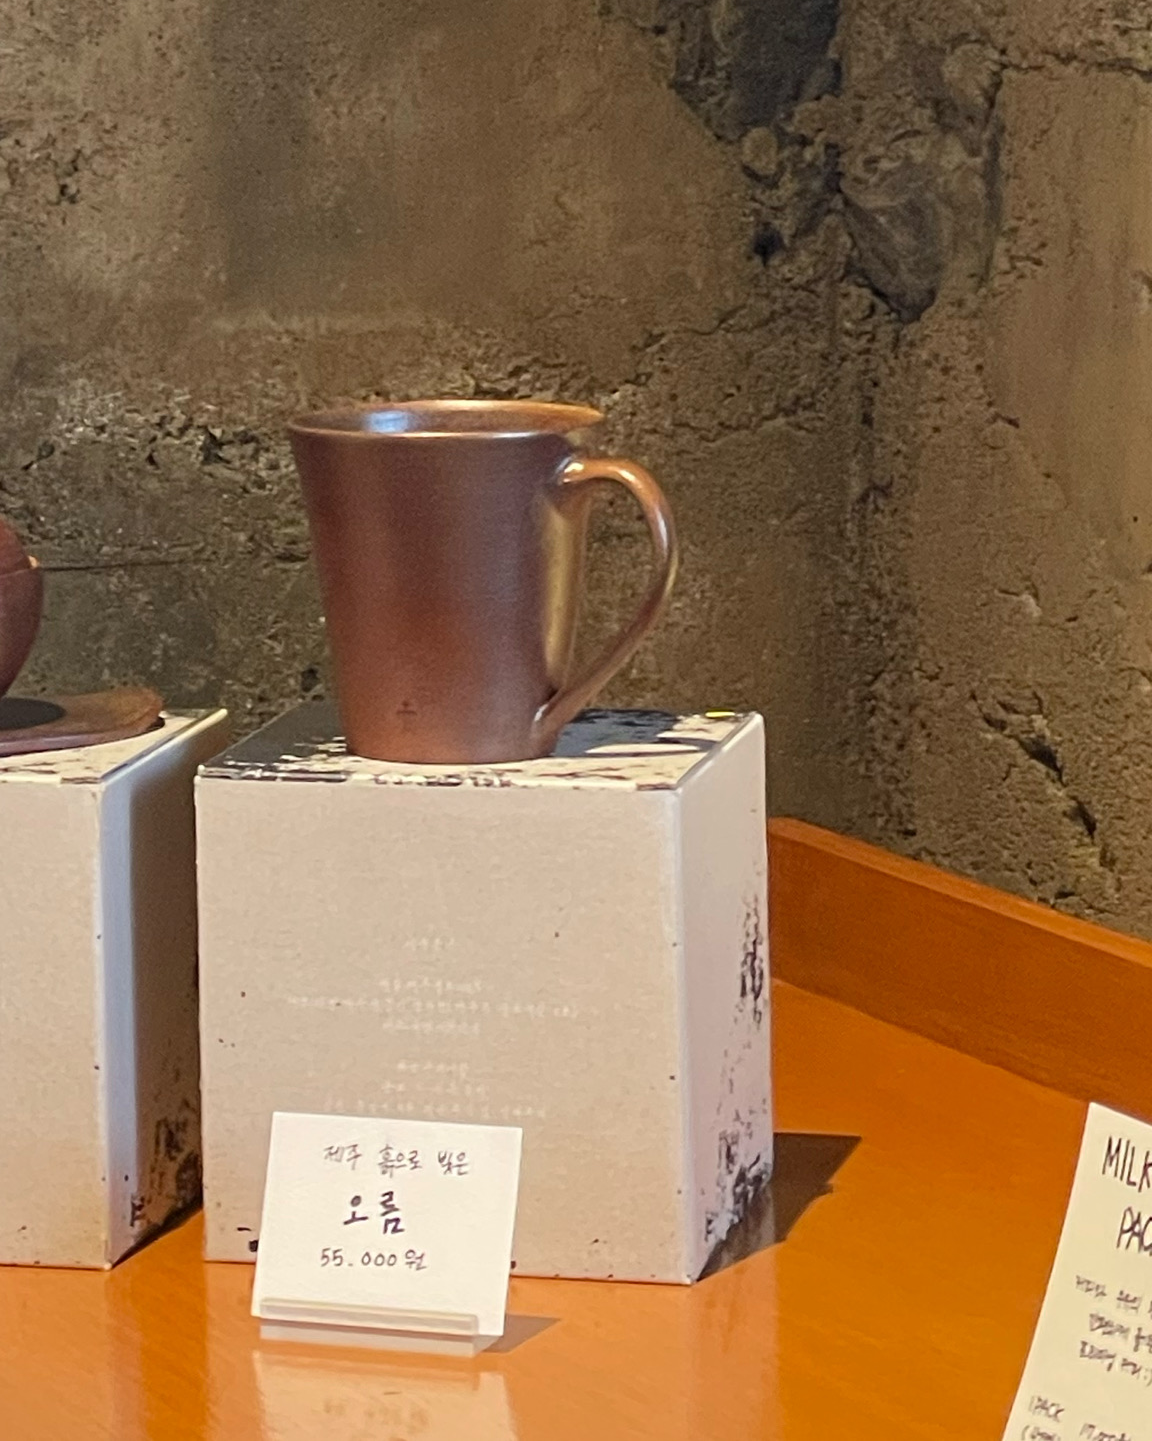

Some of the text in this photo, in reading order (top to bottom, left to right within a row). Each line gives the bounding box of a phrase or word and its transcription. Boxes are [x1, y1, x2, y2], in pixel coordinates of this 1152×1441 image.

[323, 1143, 363, 1171] 제주
[1101, 1134, 1152, 1193] MILK
[342, 1190, 406, 1236] 오름
[1115, 1205, 1152, 1258] PAC
